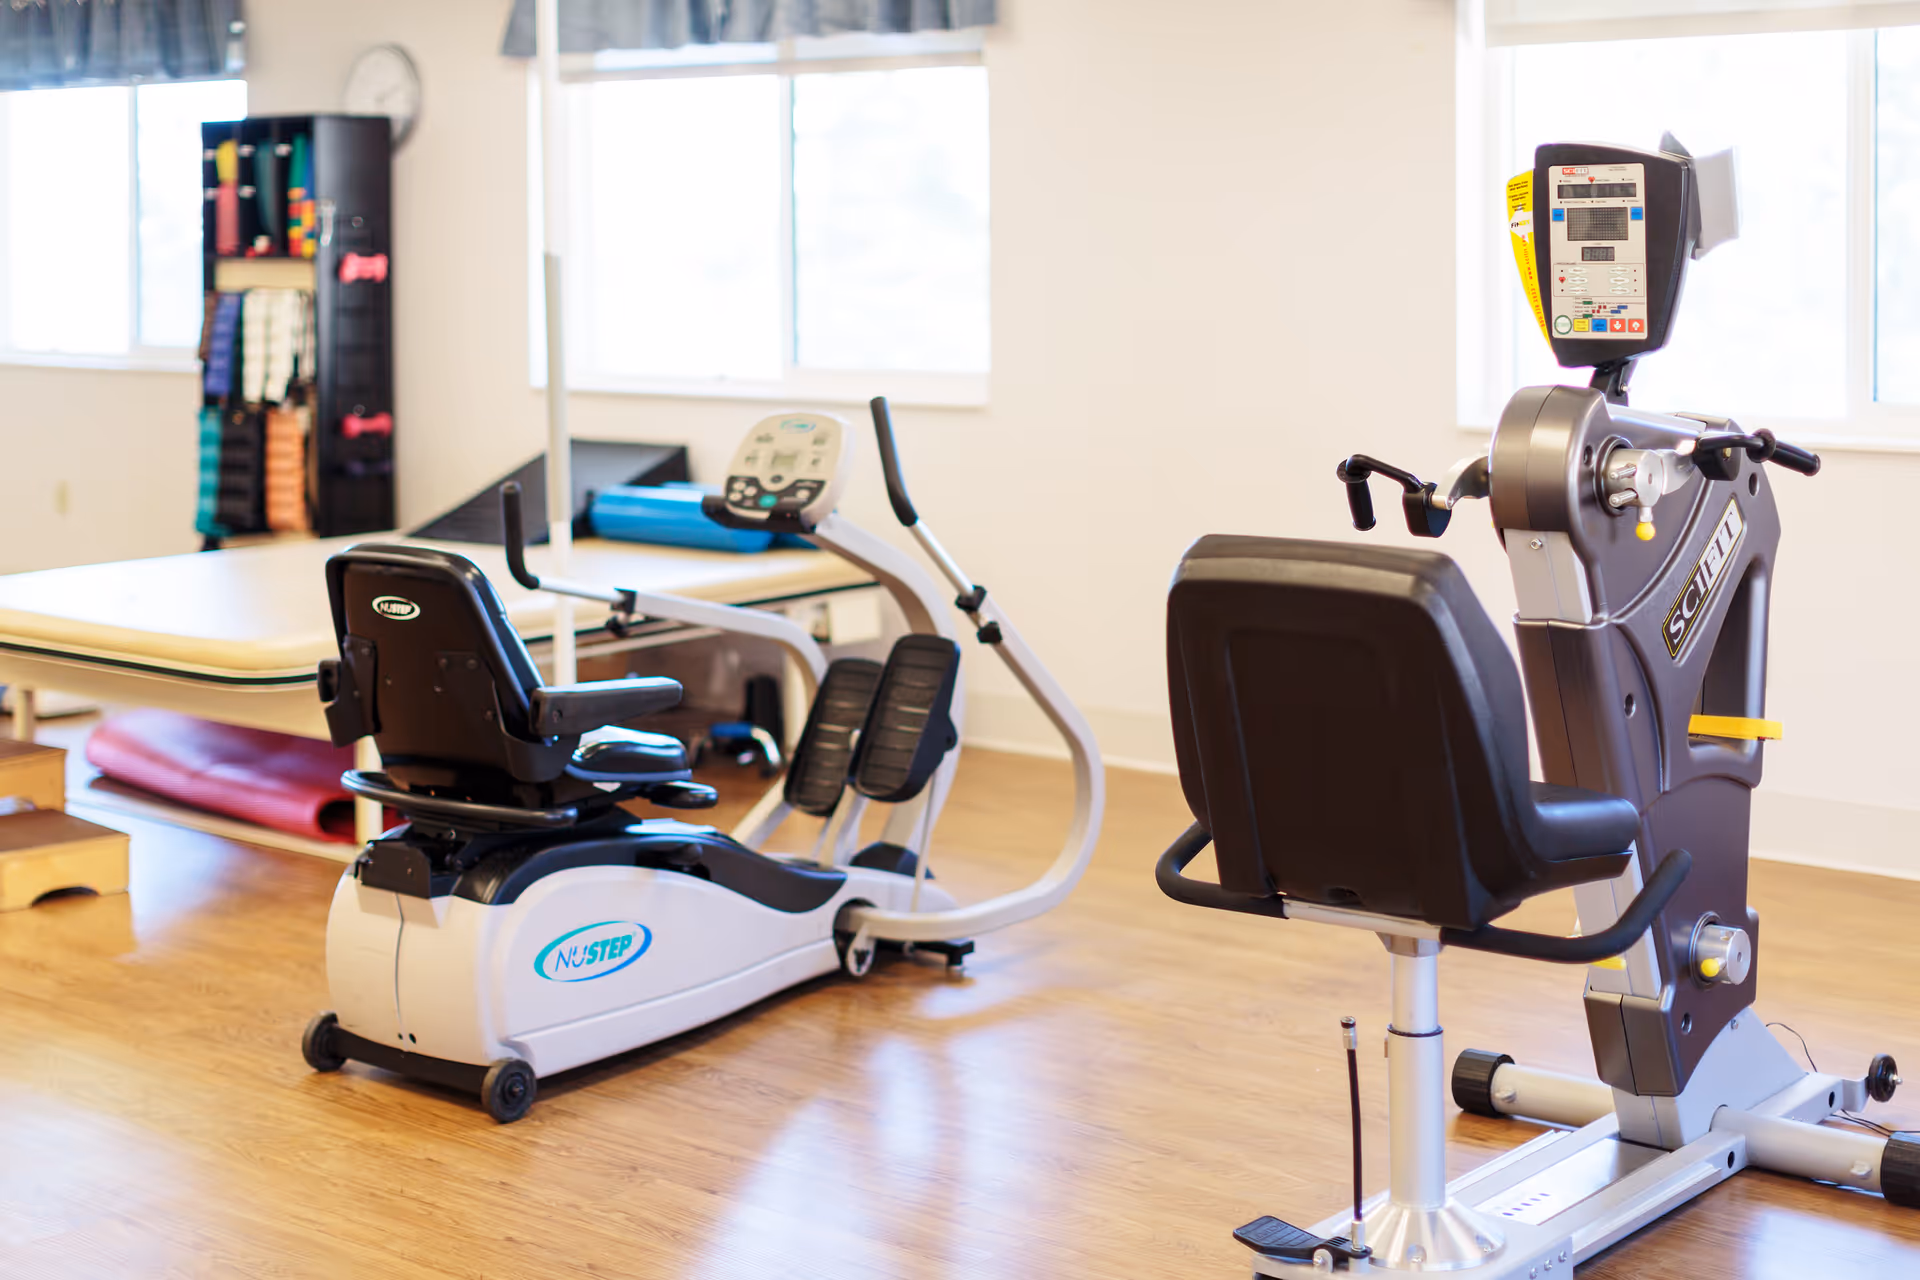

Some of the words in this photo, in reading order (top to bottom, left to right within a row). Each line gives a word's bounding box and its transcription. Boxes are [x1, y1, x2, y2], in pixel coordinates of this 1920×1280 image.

[1669, 511, 1735, 645] SCIFIT
[380, 602, 413, 615] NUSTEP
[554, 934, 633, 973] NUSTEP
